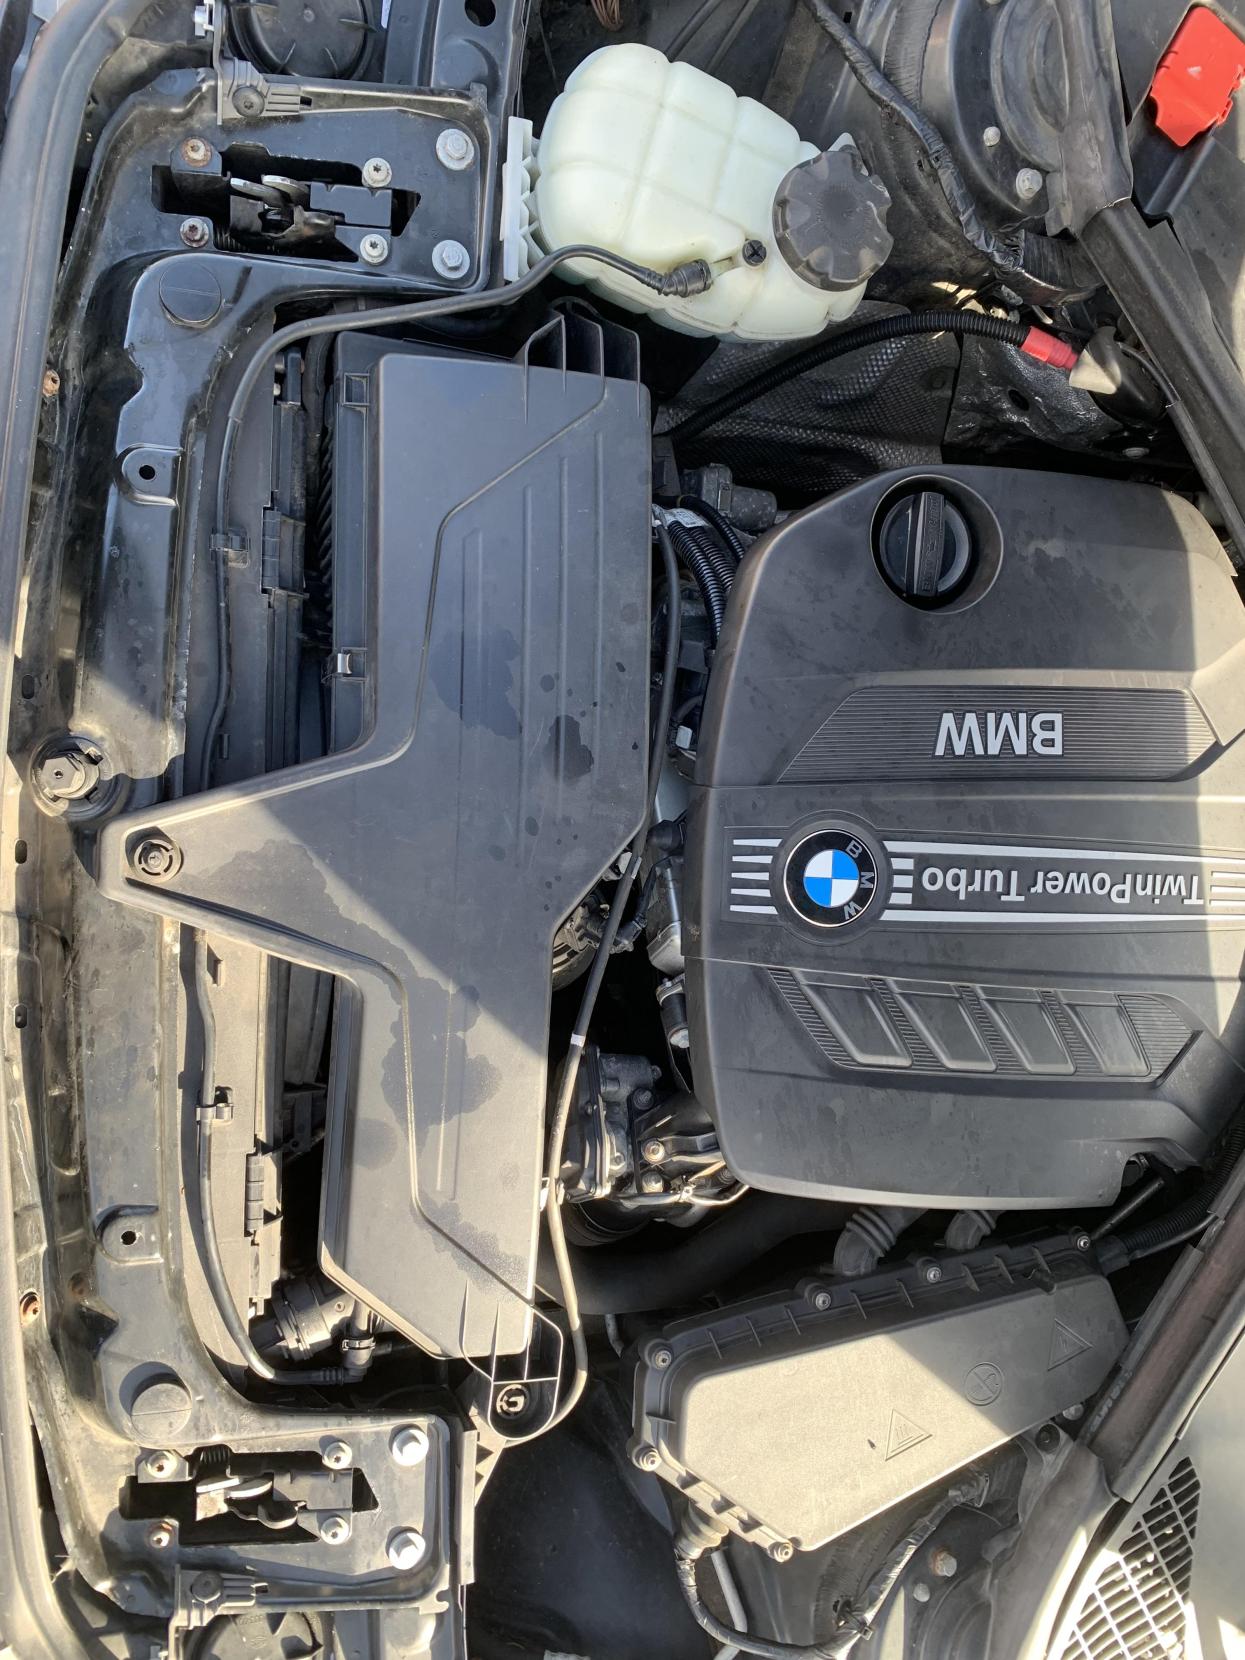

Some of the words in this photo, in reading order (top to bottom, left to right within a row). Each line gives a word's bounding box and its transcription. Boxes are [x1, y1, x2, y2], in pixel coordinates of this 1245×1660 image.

[935, 713, 1063, 756] BMW
[845, 840, 875, 920] BMW
[921, 866, 1025, 901] Turbo
[1030, 871, 1204, 904] TwinPower
